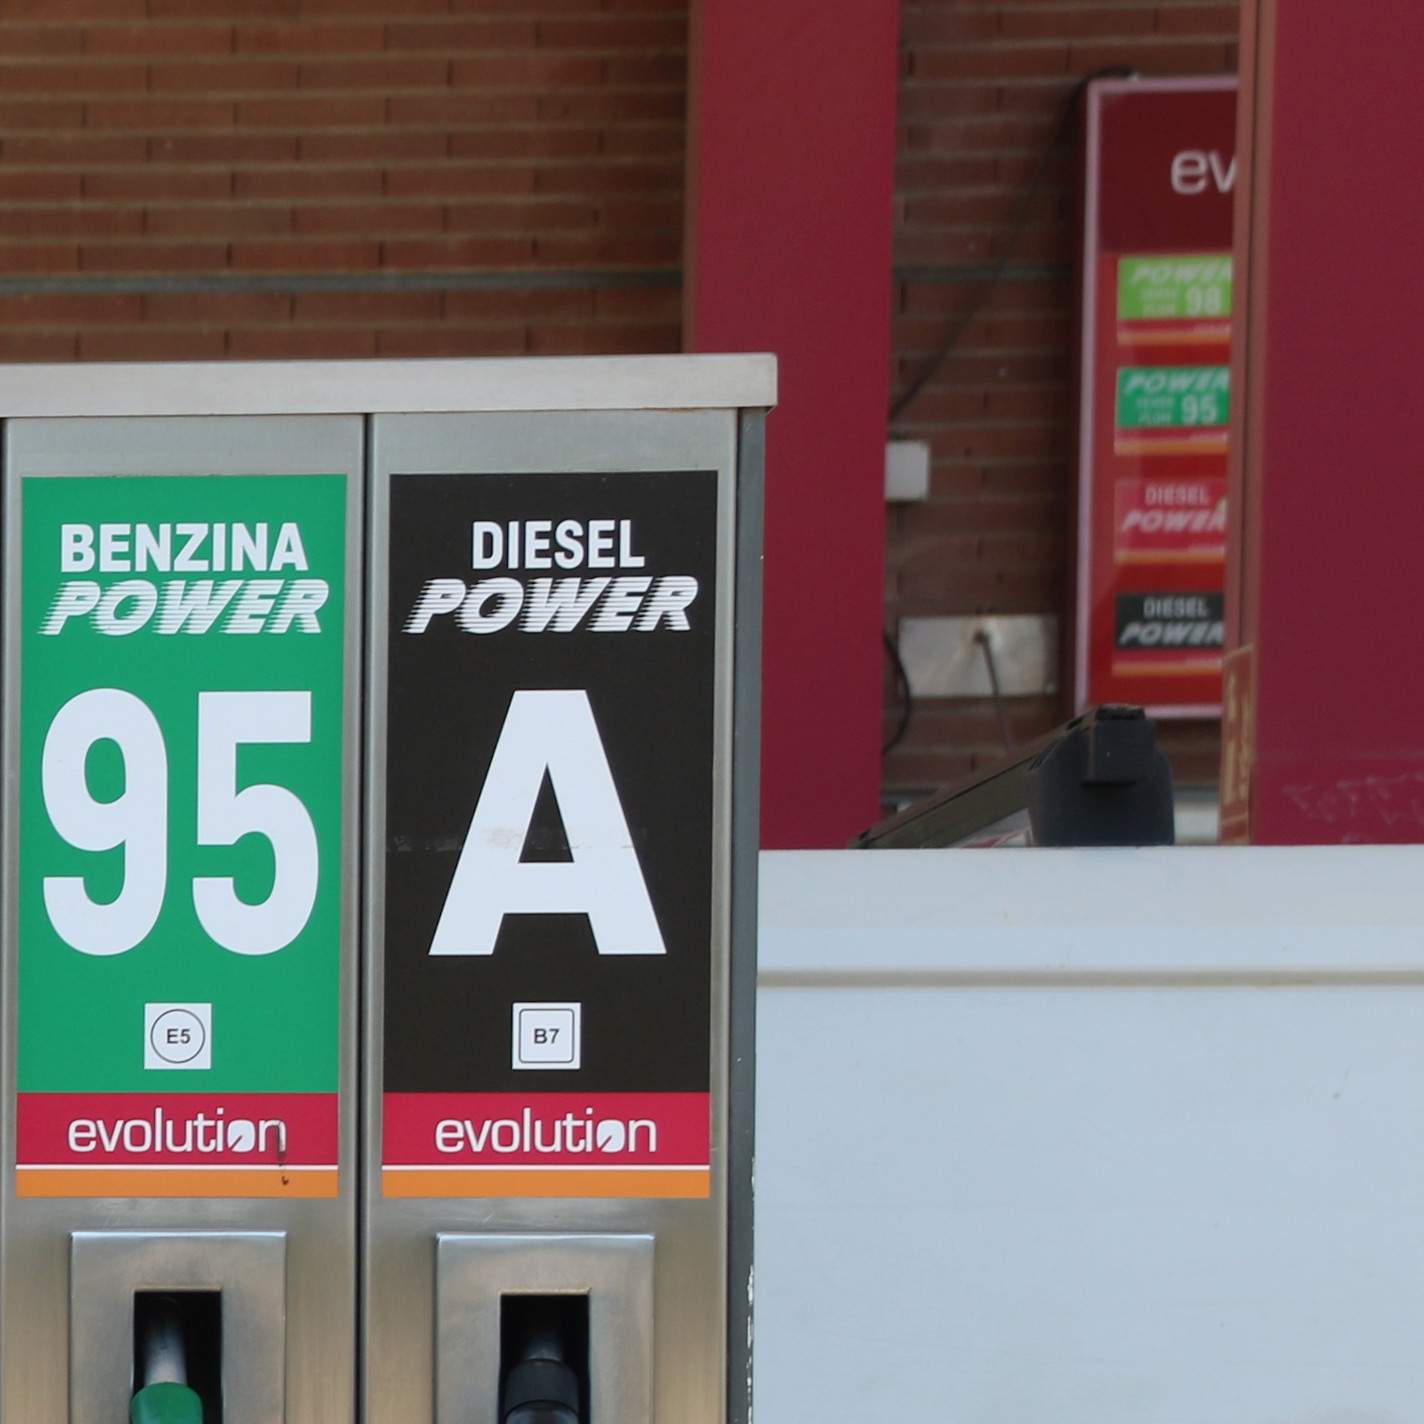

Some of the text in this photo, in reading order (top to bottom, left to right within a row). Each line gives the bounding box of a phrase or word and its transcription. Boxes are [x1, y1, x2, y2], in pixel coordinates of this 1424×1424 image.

[60, 522, 309, 573] BENZINA
[472, 519, 645, 569] DIESEL
[36, 578, 330, 636] POWER
[401, 575, 699, 634] POWER
[1143, 597, 1208, 618] DIESEL
[41, 687, 319, 956] 95
[428, 689, 667, 956] A
[166, 1027, 192, 1045] E5
[533, 1027, 561, 1045] B7
[67, 1107, 287, 1153] evolution
[435, 1107, 657, 1153] evolution
